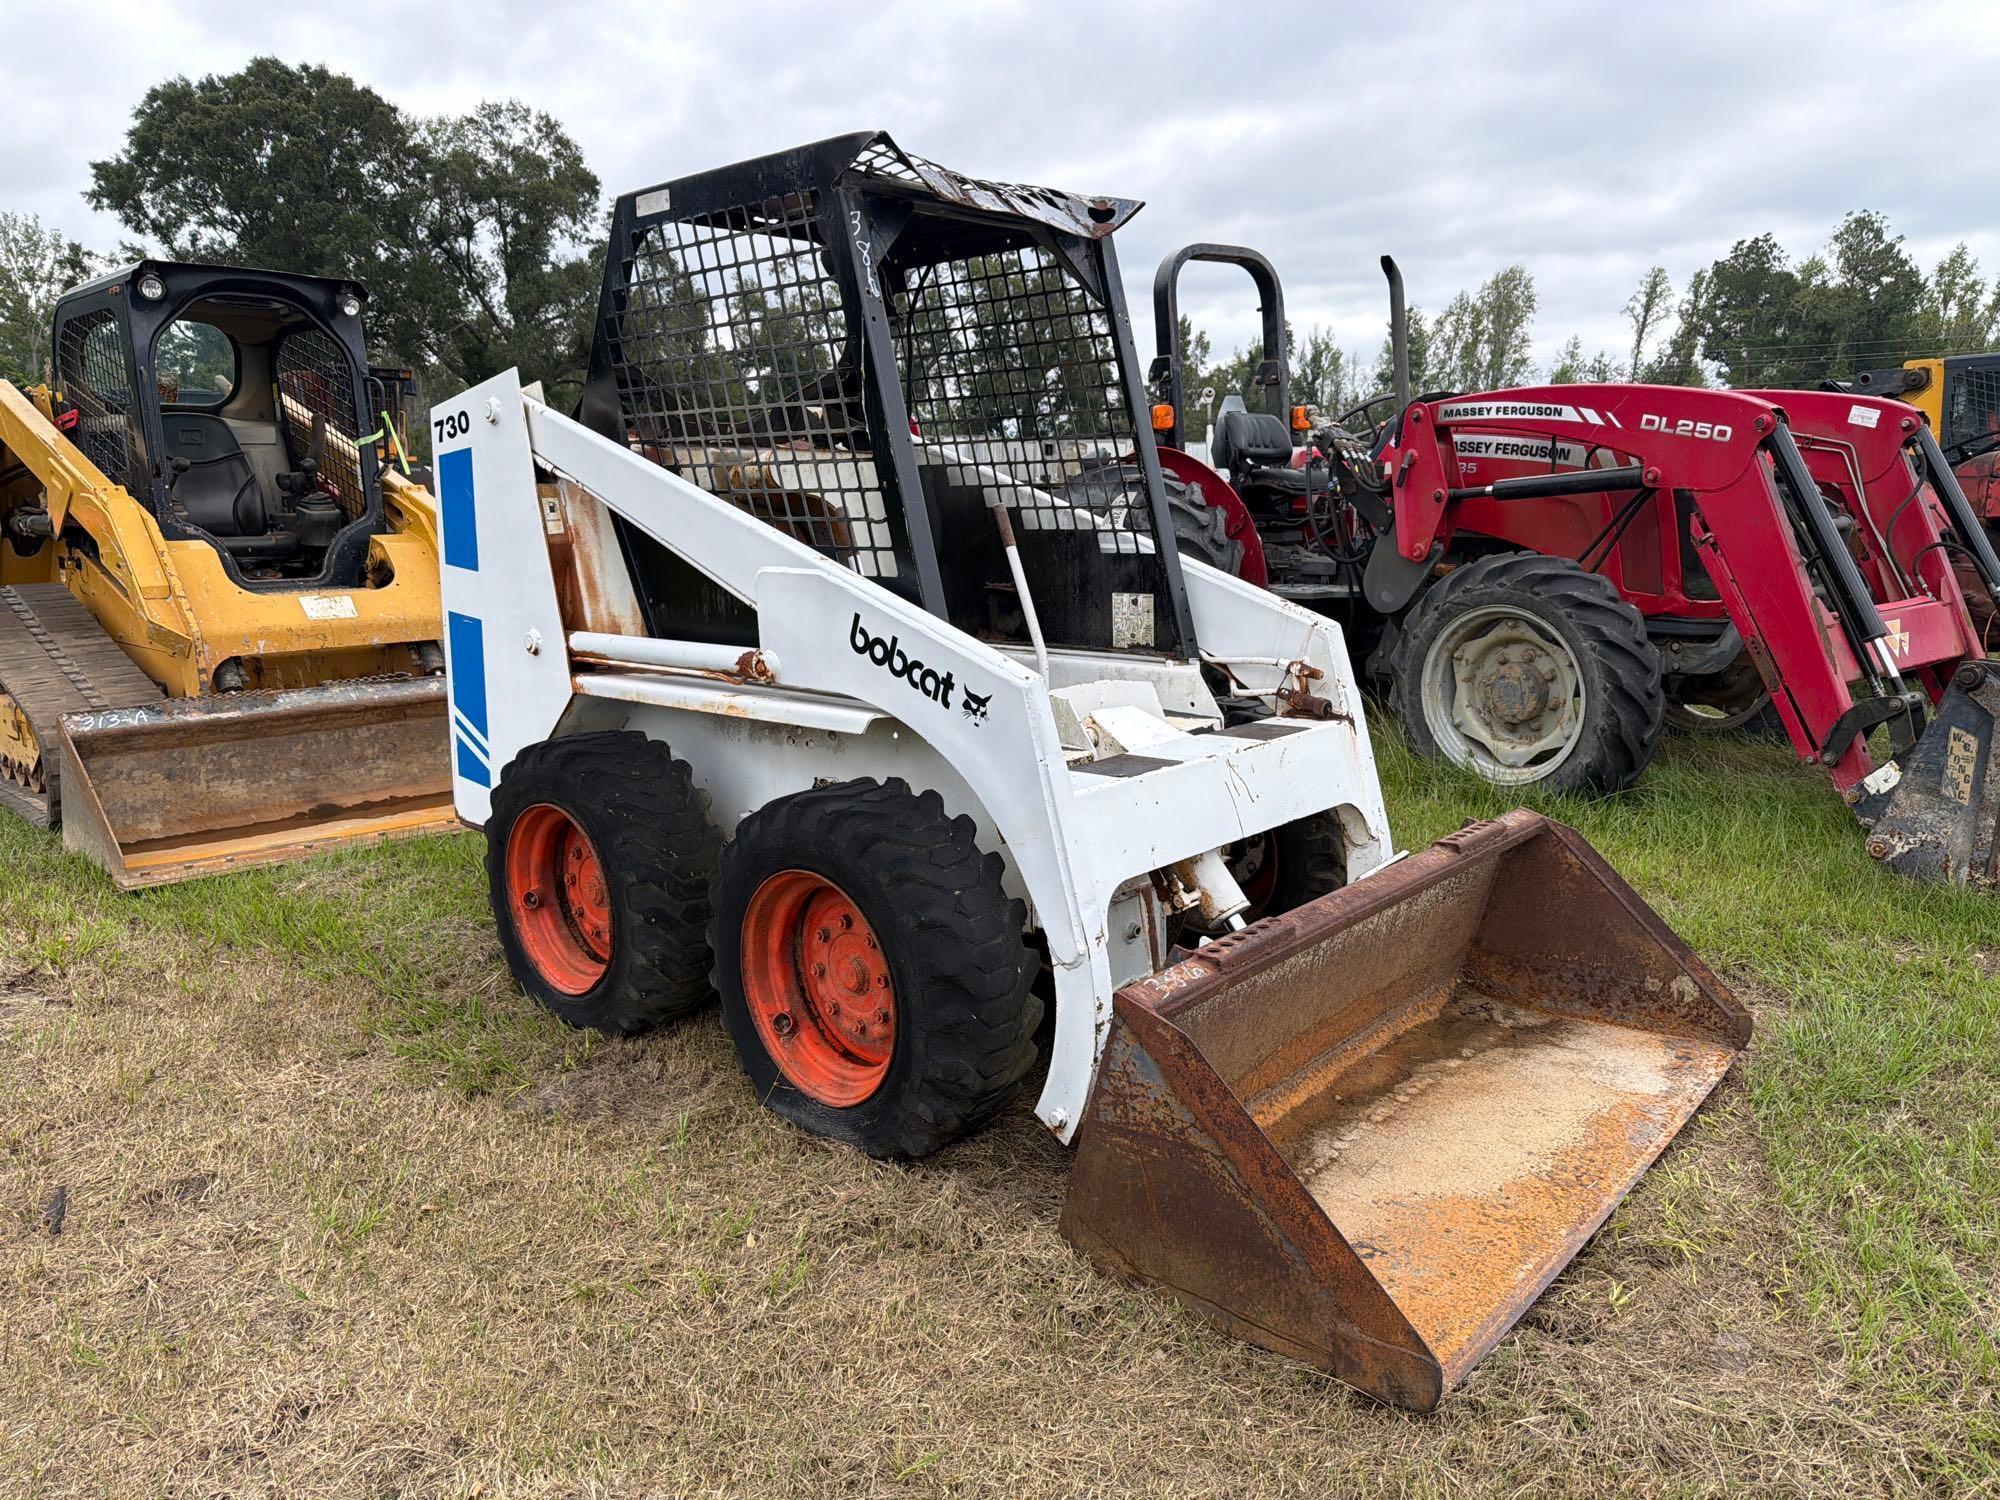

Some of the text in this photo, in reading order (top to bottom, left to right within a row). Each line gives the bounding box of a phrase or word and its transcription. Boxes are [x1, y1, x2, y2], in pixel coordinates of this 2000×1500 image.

[434, 410, 470, 443] 730
[1443, 405, 1564, 418] MASSEY FERGUSON
[1640, 413, 1732, 442] DL250
[850, 612, 955, 710] bobcat
